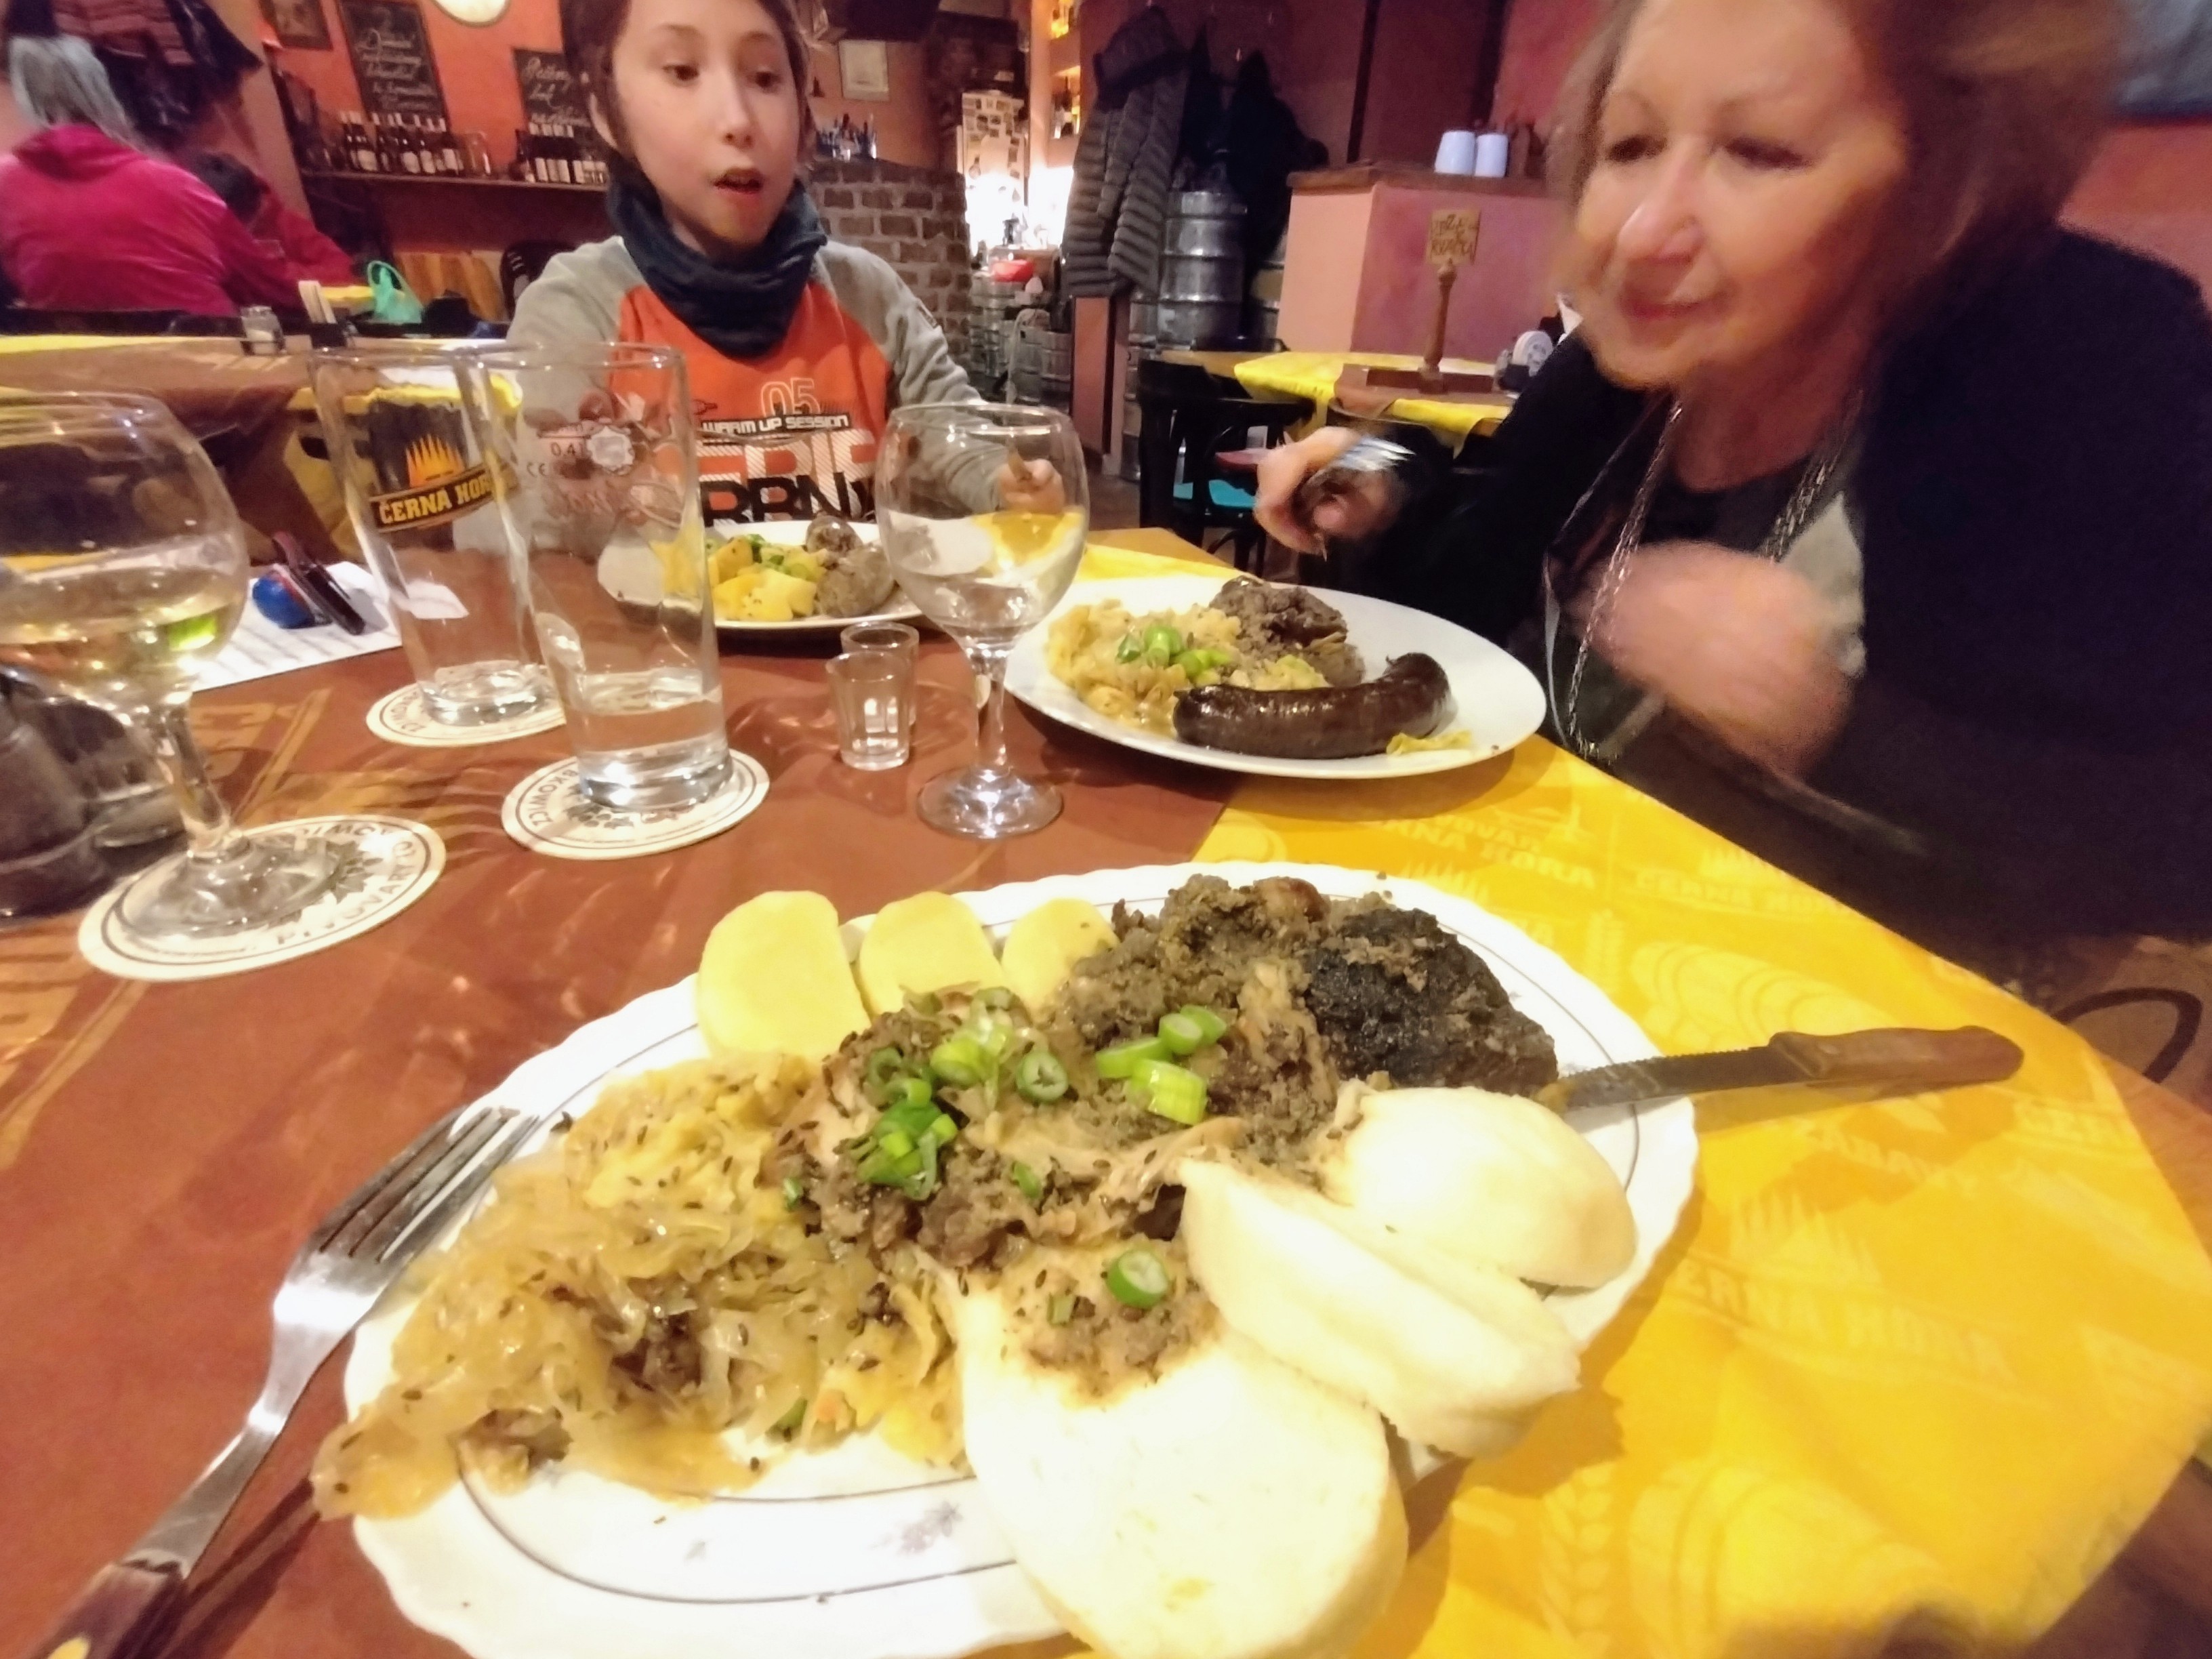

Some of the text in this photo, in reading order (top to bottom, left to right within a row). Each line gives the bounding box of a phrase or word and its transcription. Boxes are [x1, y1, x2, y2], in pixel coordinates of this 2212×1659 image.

[702, 414, 848, 436] WARM UP SESSION
